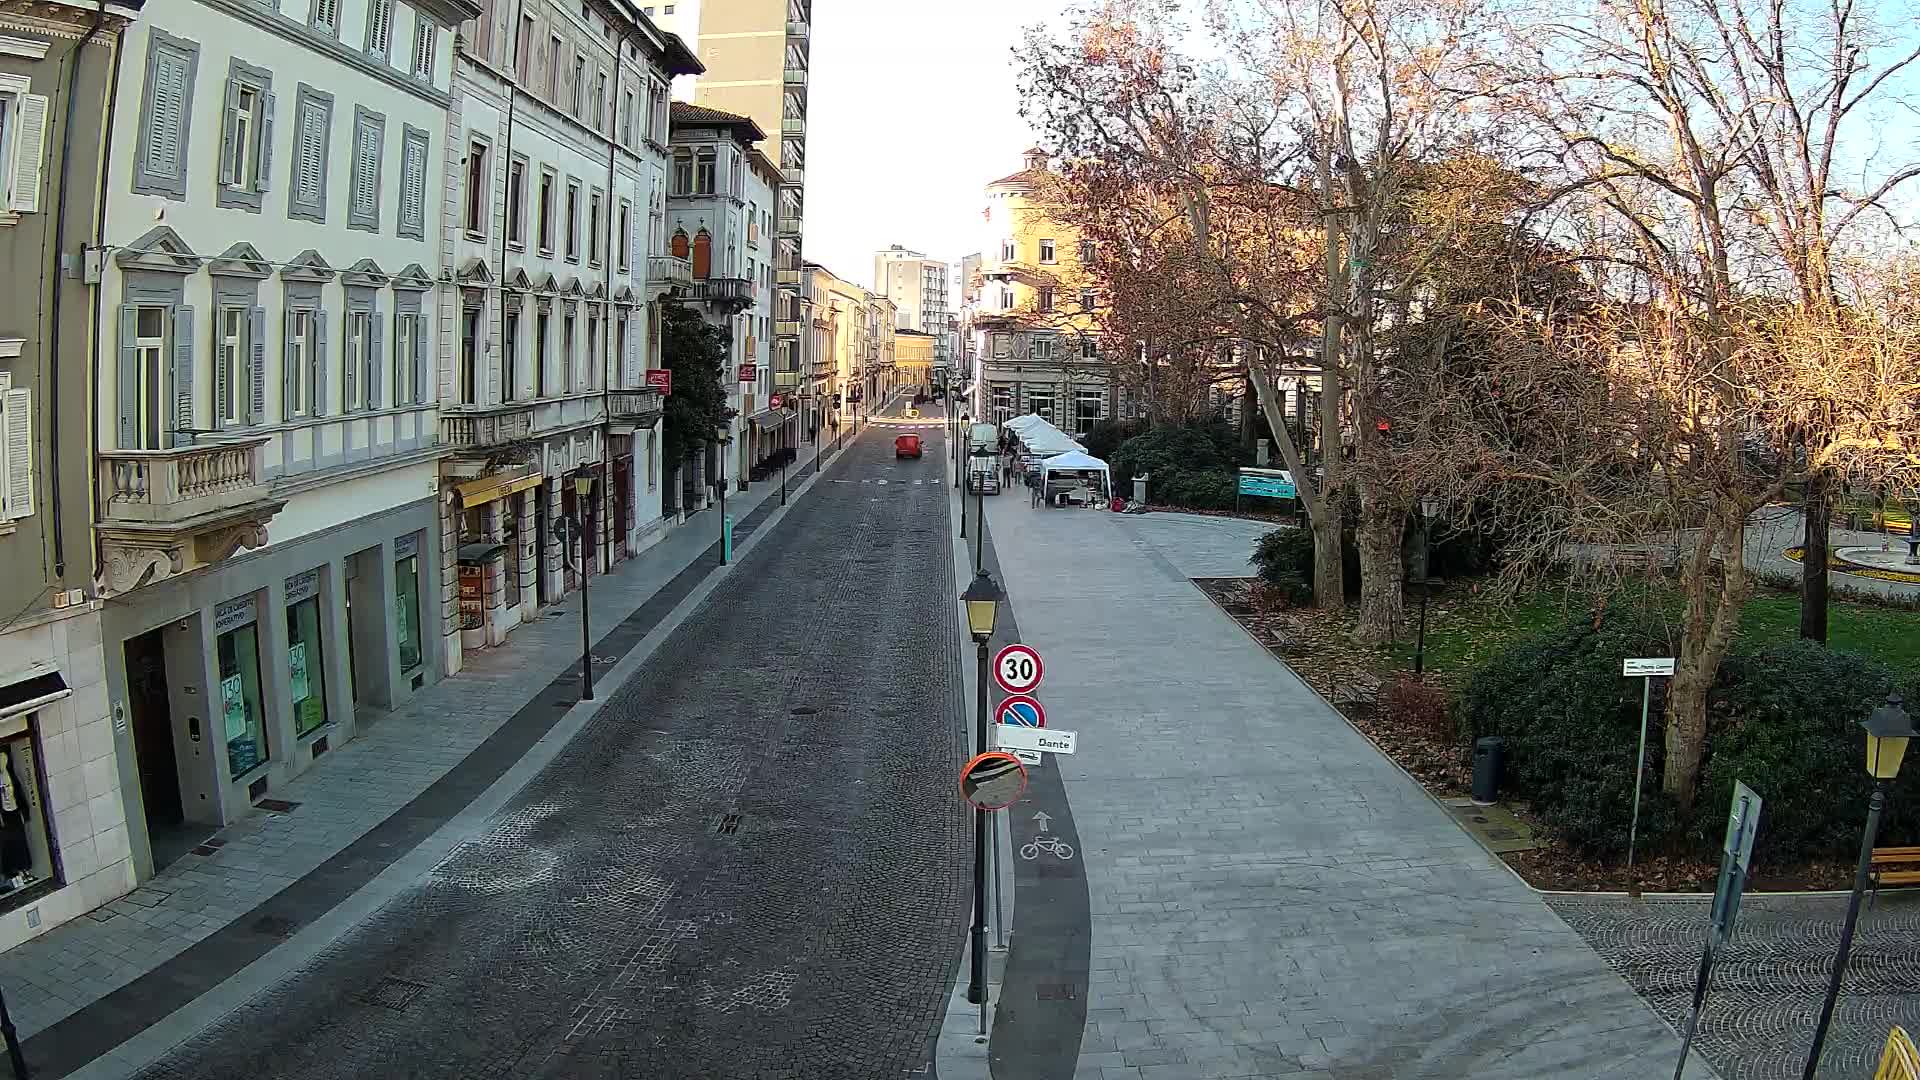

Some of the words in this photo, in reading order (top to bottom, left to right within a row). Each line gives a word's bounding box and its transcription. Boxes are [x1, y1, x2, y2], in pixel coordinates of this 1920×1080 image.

[1005, 658, 1033, 680] 30
[222, 677, 241, 700] 130
[1038, 738, 1070, 749] Dante
